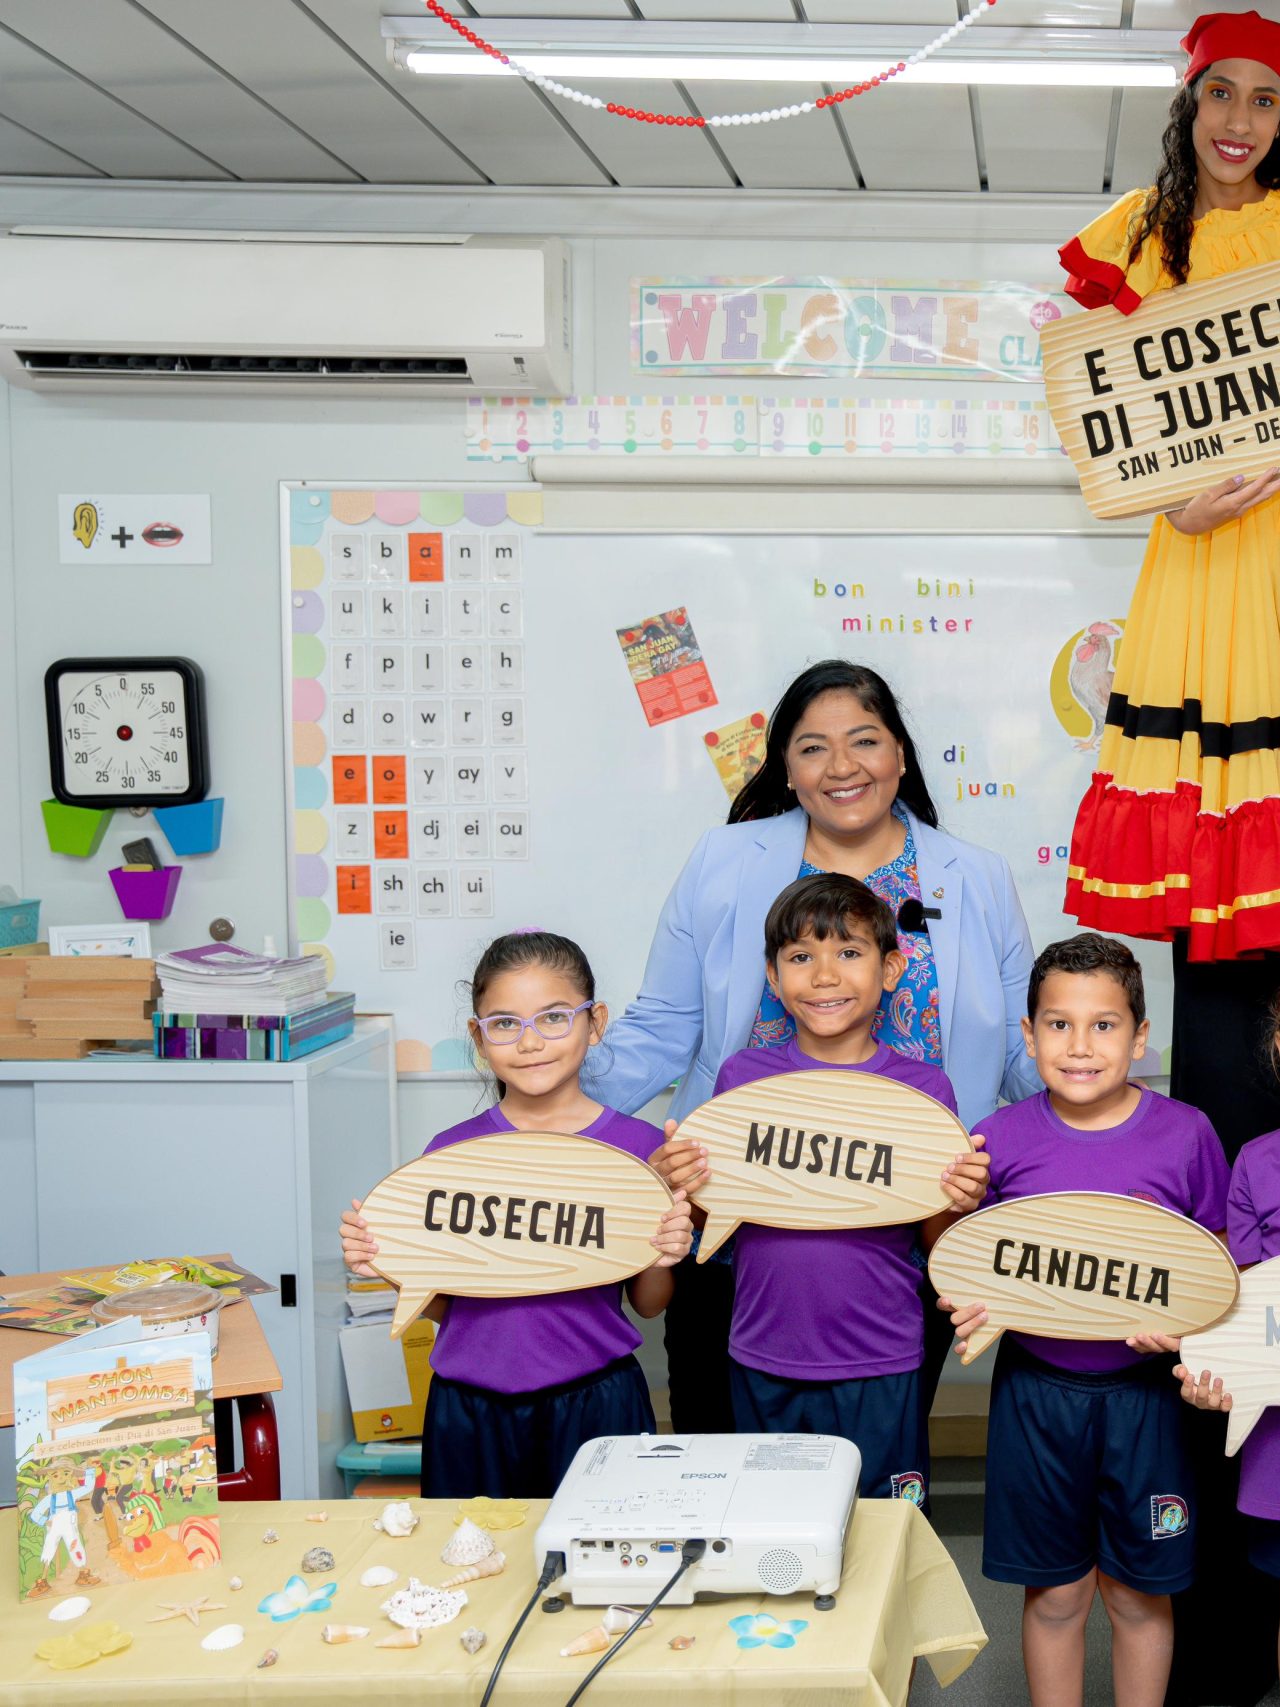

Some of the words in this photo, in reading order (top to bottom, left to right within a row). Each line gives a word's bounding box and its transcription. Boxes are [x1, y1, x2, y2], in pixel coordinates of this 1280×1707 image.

[658, 293, 979, 363] WELCOME
[1084, 348, 1113, 396] E
[481, 411, 489, 435] 1
[515, 411, 529, 435] 2
[551, 411, 565, 435] 3
[587, 411, 600, 435] 4
[624, 411, 636, 435] 5
[660, 411, 673, 435] 6
[696, 411, 709, 435] 7
[732, 411, 746, 435] 8
[771, 412, 784, 438] 9
[806, 412, 824, 438] 10
[843, 412, 858, 438] 11
[878, 412, 895, 438] 12
[913, 412, 931, 438] 13
[949, 412, 968, 438] 14
[985, 412, 1003, 438] 15
[1020, 412, 1040, 438] 16
[1081, 403, 1133, 458] DI
[1117, 451, 1160, 482] SAN
[1167, 433, 1224, 469] JUAN
[344, 547, 351, 558] s
[381, 542, 392, 558] b
[420, 547, 432, 558] a
[460, 548, 470, 558] n
[496, 548, 512, 558] m
[813, 578, 865, 597] bon
[917, 577, 975, 597] bini
[342, 603, 352, 613] u
[383, 598, 392, 613] k
[425, 599, 429, 614] i
[463, 600, 469, 614] t
[500, 603, 510, 614] c
[842, 614, 973, 633] minister
[650, 634, 674, 650] JUAN
[345, 653, 352, 669] f
[383, 658, 394, 672] p
[462, 658, 472, 668] e
[501, 652, 511, 667] h
[95, 685, 102, 696] 5
[120, 677, 126, 689] 0
[141, 684, 155, 695] 55
[73, 703, 85, 714] 10
[162, 702, 175, 713] 50
[343, 708, 354, 724] d
[383, 713, 394, 723] o
[421, 713, 435, 723] w
[465, 712, 471, 722] r
[502, 712, 512, 726] g
[68, 729, 81, 739] 15
[170, 727, 183, 739] 45
[75, 752, 88, 764] 20
[164, 751, 178, 762] 40
[943, 745, 966, 762] di
[96, 771, 109, 782] 25
[121, 777, 135, 788] 30
[148, 771, 161, 782] 35
[344, 769, 354, 779] e
[384, 770, 395, 781] o
[424, 770, 434, 784] y
[458, 769, 479, 783] ay
[505, 768, 514, 778] v
[957, 777, 1015, 800] juan
[348, 824, 356, 834] z
[386, 824, 396, 835] u
[424, 820, 439, 839] dj
[464, 820, 479, 835] ei
[500, 825, 522, 835] ou
[351, 874, 356, 890] i
[384, 875, 403, 890] sh
[423, 878, 444, 893] ch
[468, 878, 482, 893] ui
[390, 931, 404, 945] ie
[745, 1122, 894, 1188] MUSICA
[423, 1189, 605, 1249] COSECHA
[993, 1238, 1171, 1307] CANDELA
[87, 1366, 153, 1389] SHON
[51, 1384, 190, 1423] WANTOMBA
[680, 1472, 727, 1480] EPSON
